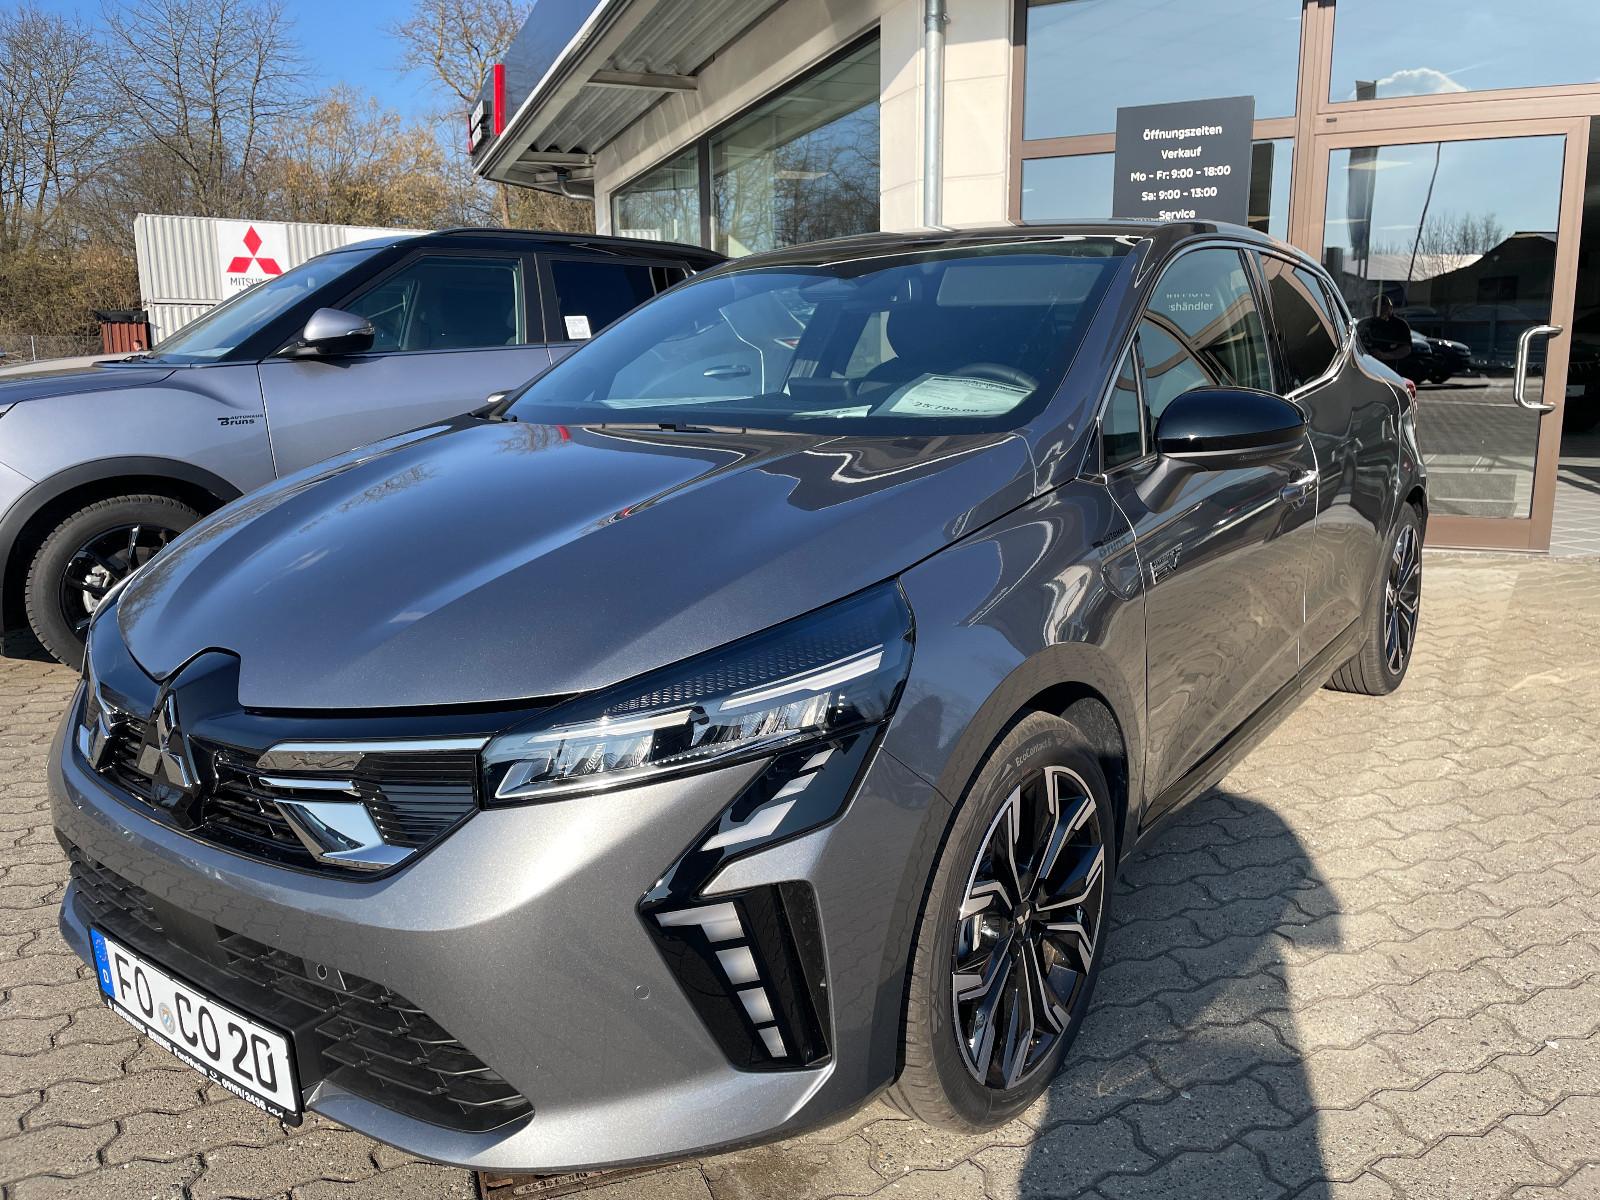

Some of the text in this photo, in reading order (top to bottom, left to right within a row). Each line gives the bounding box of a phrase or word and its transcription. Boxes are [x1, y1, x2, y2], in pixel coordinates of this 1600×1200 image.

[1143, 125, 1222, 141] Öffnungszeiten
[1161, 146, 1202, 160] Verkauf
[1130, 171, 1147, 182] Mo
[1156, 169, 1170, 180] Fr:
[1171, 168, 1194, 179] 9:00
[1203, 165, 1231, 177] 18:00
[1141, 191, 1157, 202] Sa:
[1158, 189, 1181, 200] 9:00
[1190, 186, 1218, 198] 13:00
[1159, 209, 1196, 220] Service
[230, 277, 262, 287] MITSU
[217, 417, 255, 426] Bruns
[102, 952, 278, 1093] D FO CO 20
